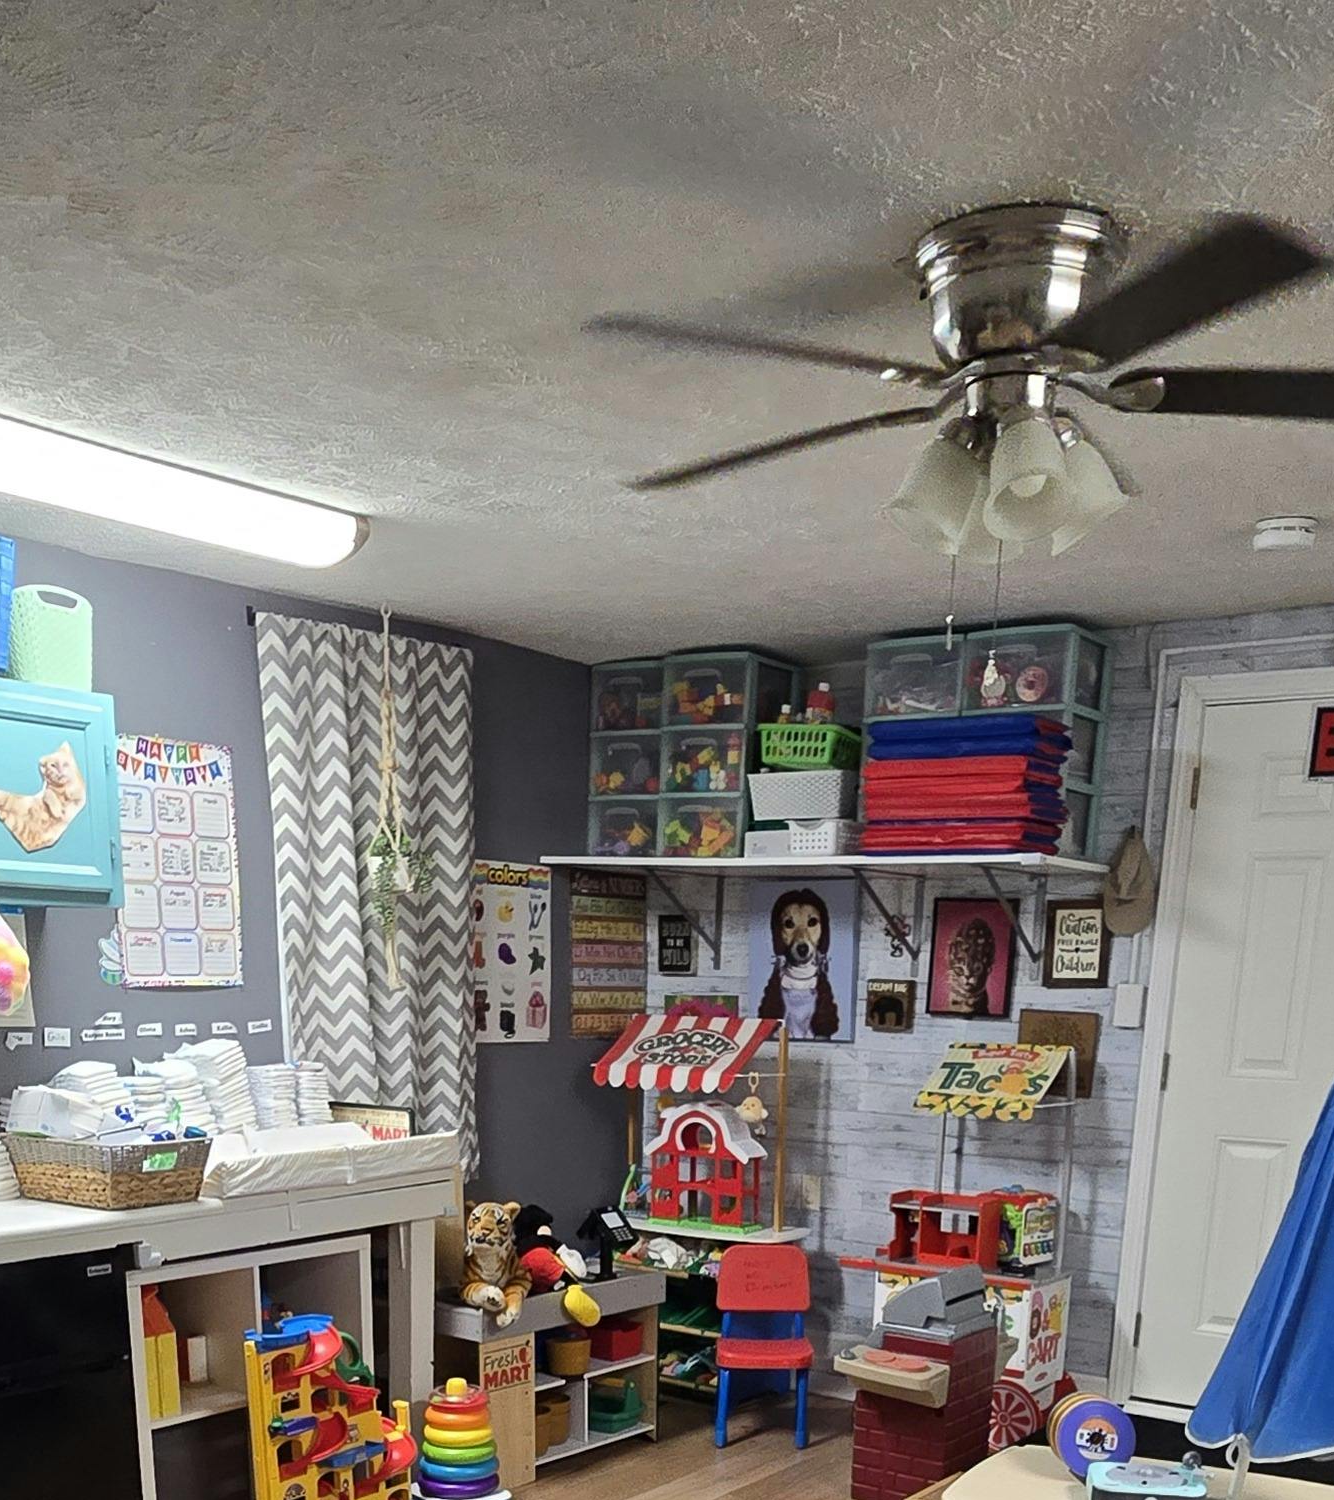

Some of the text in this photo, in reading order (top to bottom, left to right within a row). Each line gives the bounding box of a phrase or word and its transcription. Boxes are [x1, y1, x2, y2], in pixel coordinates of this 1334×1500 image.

[136, 737, 200, 763] HAPPY
[117, 749, 223, 785] BIRTHDAY
[488, 868, 529, 885] colors
[638, 1032, 734, 1053] GROCERY
[644, 1053, 712, 1064] STORE
[483, 1349, 518, 1372] Fresh
[1027, 1333, 1062, 1370] CART
[484, 1363, 531, 1390] MART
